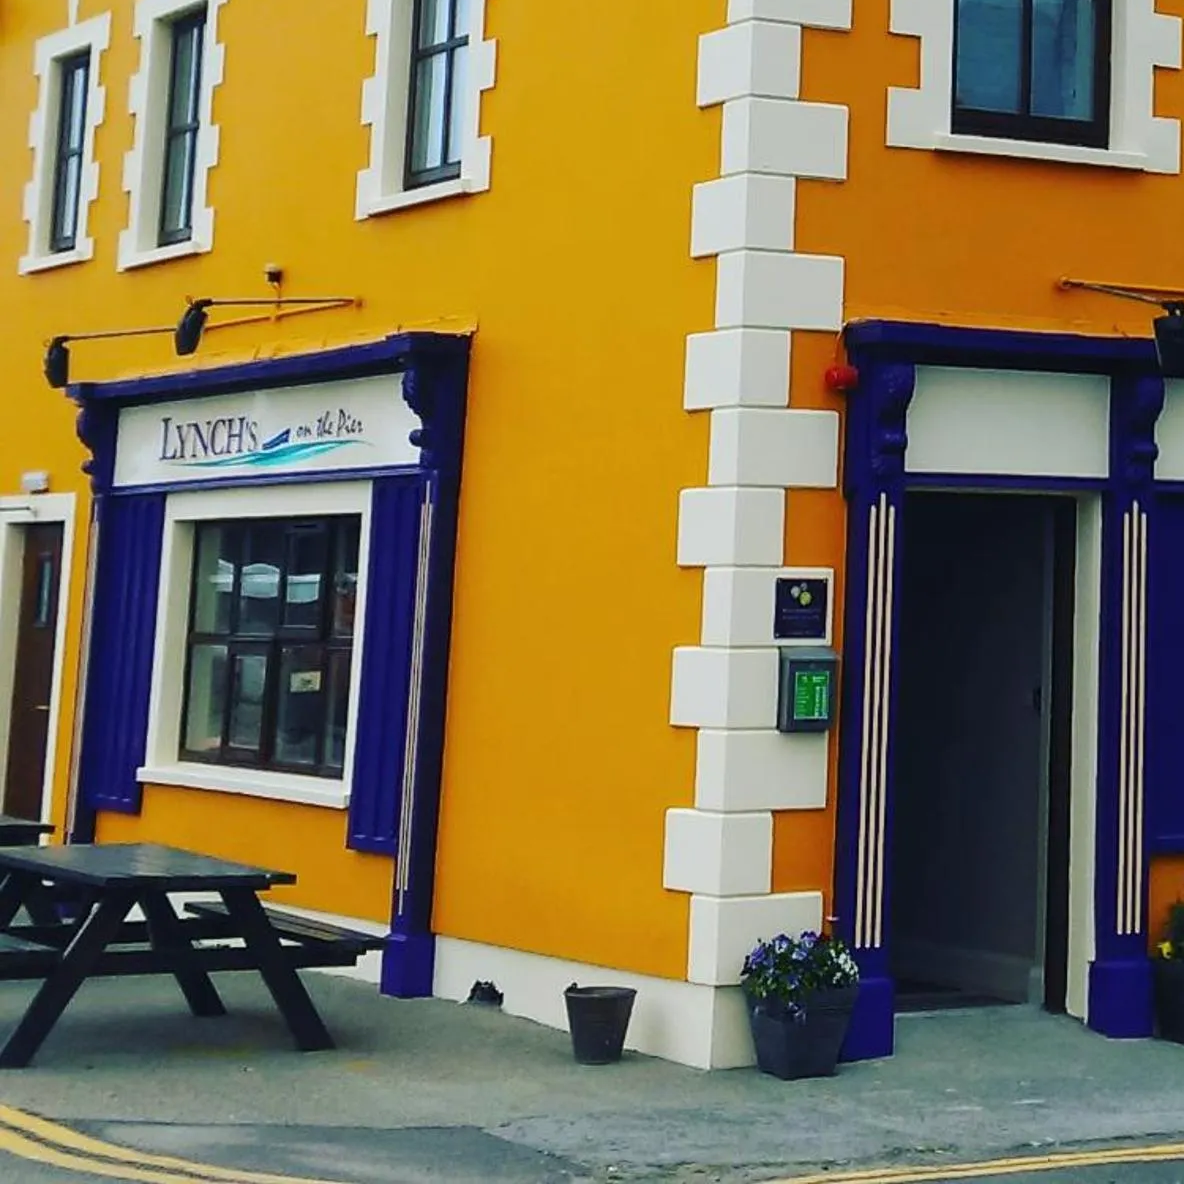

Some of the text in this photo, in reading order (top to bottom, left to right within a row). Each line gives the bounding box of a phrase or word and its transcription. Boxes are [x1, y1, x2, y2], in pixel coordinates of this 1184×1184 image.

[158, 408, 363, 461] LYNCH'S on the Pier
